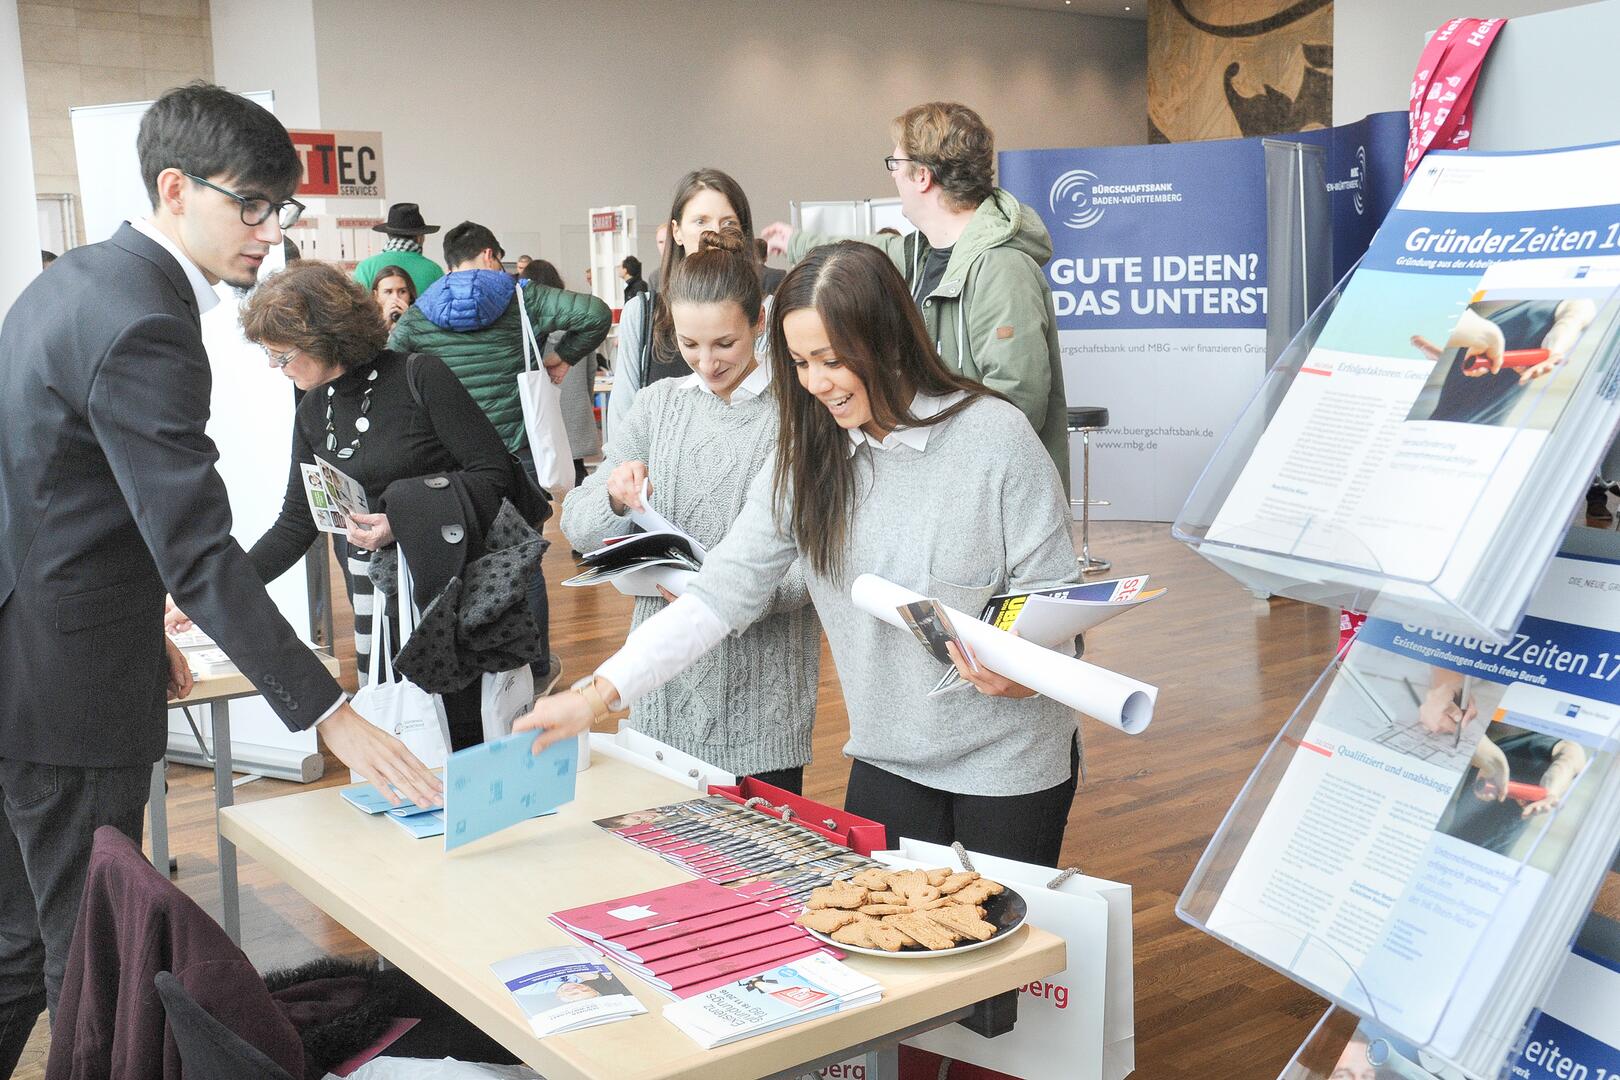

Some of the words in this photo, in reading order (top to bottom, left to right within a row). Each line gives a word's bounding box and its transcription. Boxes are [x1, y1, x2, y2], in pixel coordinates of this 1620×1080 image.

[294, 144, 377, 185] TTEC
[340, 186, 378, 196] SERVICES
[1092, 182, 1173, 195] BÜRGSCHAFTSBANK
[1092, 193, 1183, 206] BADEN-WÜRTTEMBERG
[1404, 224, 1597, 255] GründerZeiten
[1598, 222, 1620, 249] 1
[1050, 257, 1143, 285] GUTE
[1152, 253, 1259, 284] IDEEN?
[1395, 256, 1436, 269] Gründung
[1436, 260, 1451, 268] aus
[1452, 258, 1467, 269] der
[1053, 289, 1121, 317] DAS
[1129, 344, 1145, 353] und
[1148, 343, 1171, 353] MBG
[1181, 344, 1194, 353] wir
[1197, 343, 1242, 353] finanzieren
[1095, 440, 1158, 451] www.mbg.de
[1392, 635, 1474, 668] Existenzgründungen
[1473, 657, 1498, 674] durch
[1497, 663, 1519, 679] freie
[1518, 669, 1548, 687] Berufe
[1337, 744, 1385, 770] Qualifiziert
[1384, 765, 1403, 777] und
[703, 1003, 746, 1028] Existenz
[1520, 1038, 1588, 1080] eiten
